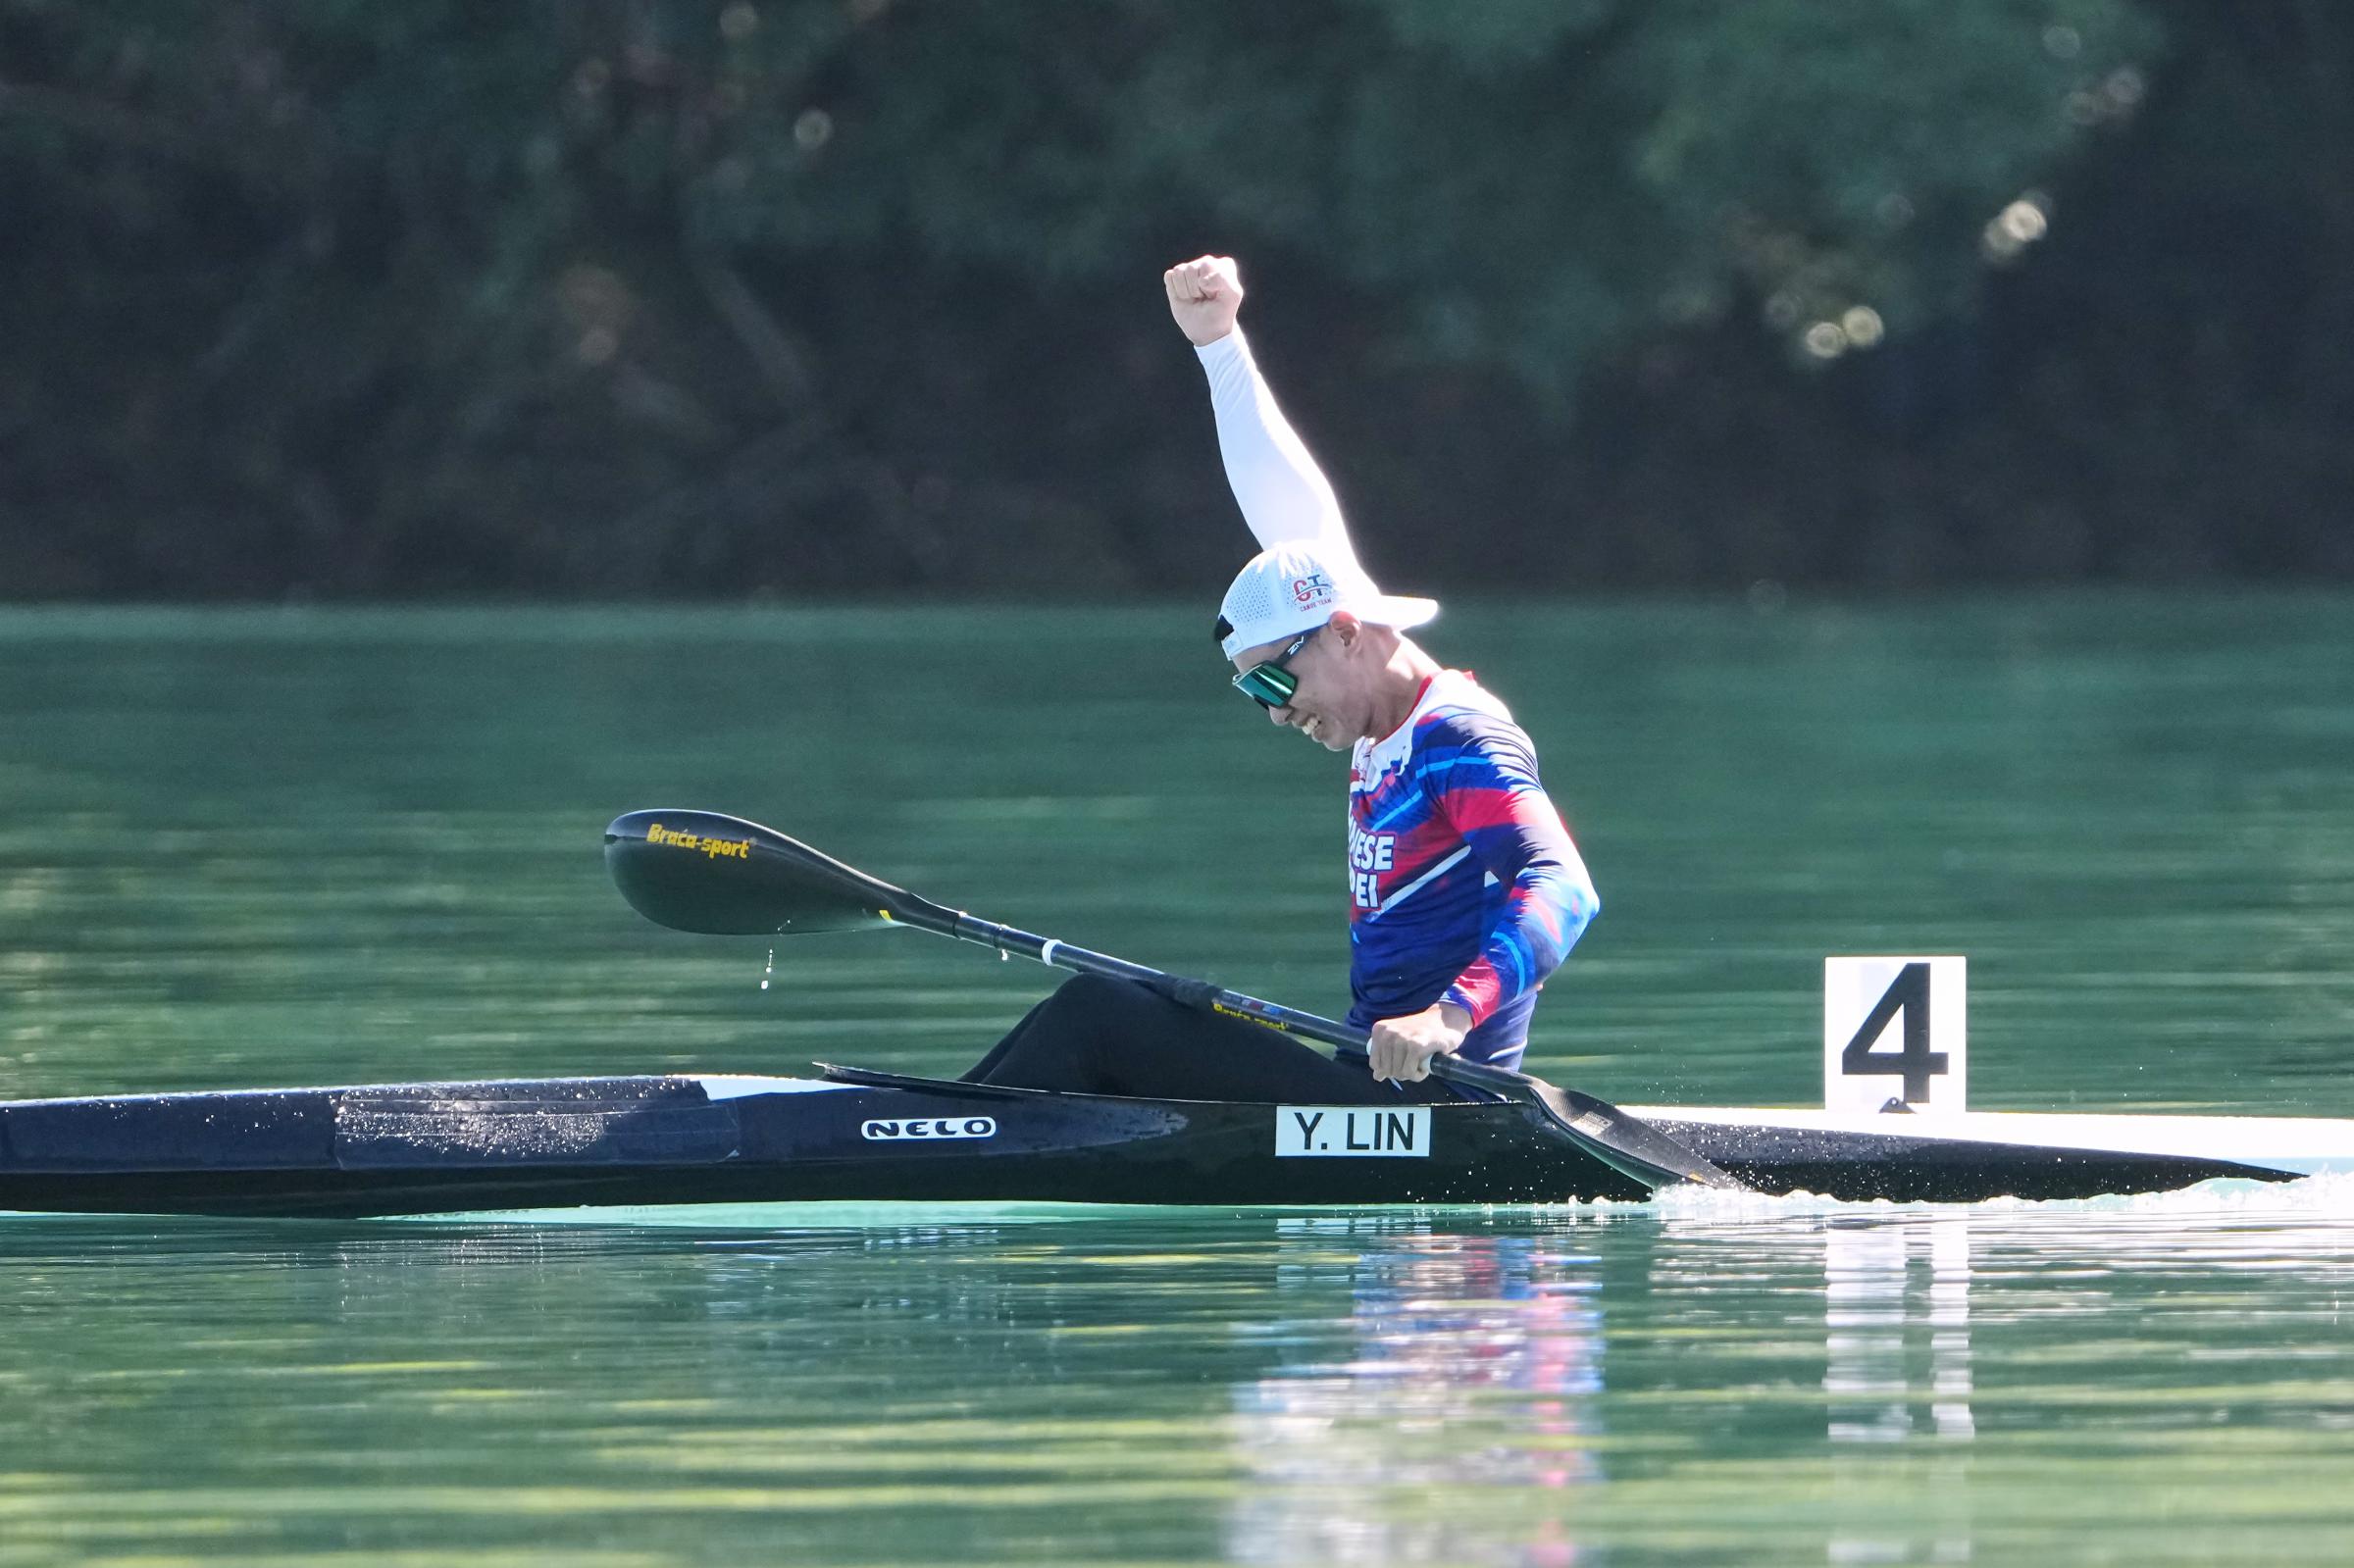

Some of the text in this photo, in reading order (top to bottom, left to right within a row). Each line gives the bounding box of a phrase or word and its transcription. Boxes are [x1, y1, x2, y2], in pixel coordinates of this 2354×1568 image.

[1349, 821, 1395, 871] NESE
[1842, 962, 1949, 1103] 4
[867, 1119, 992, 1138] NELO
[1294, 1112, 1414, 1150] Y. LIN
